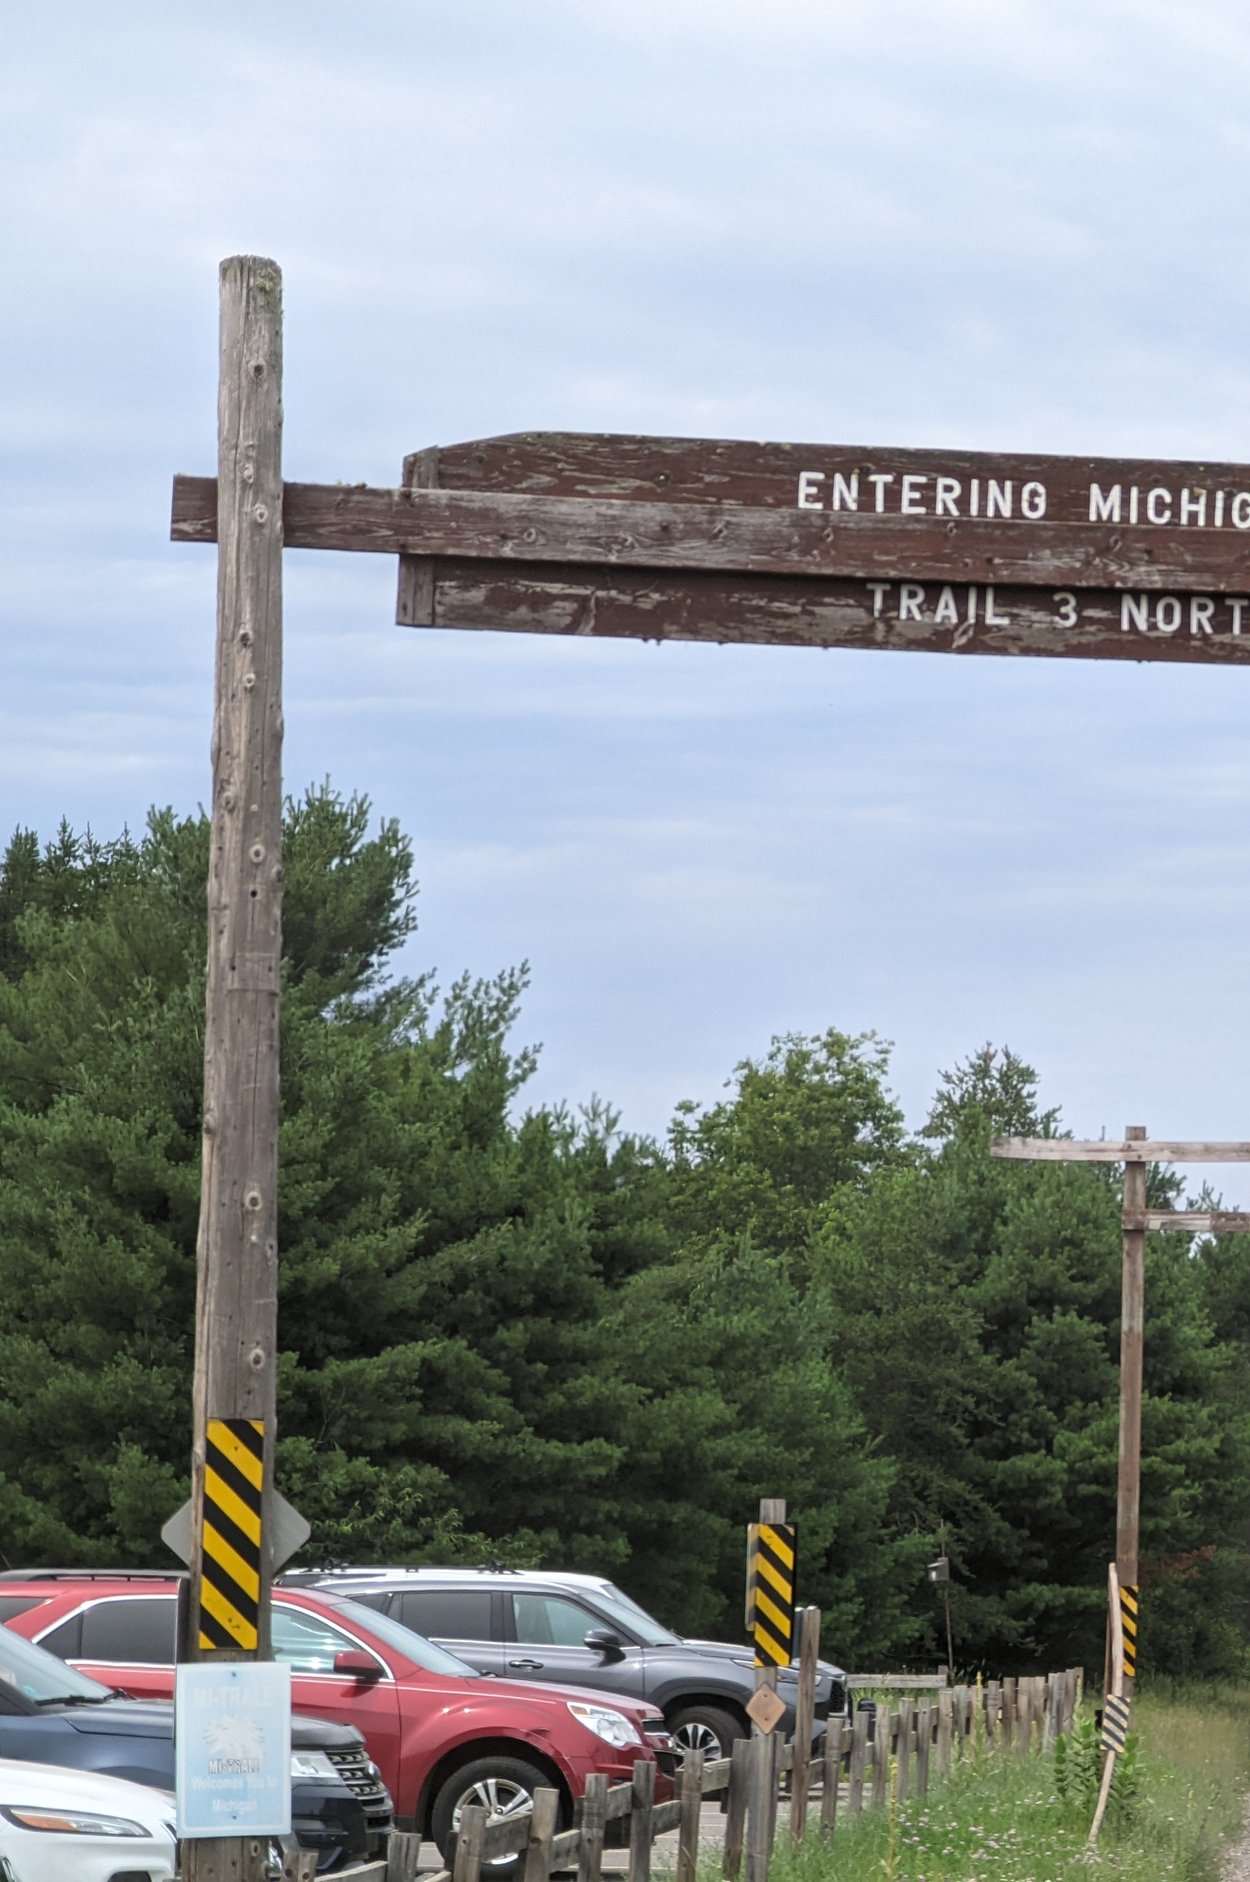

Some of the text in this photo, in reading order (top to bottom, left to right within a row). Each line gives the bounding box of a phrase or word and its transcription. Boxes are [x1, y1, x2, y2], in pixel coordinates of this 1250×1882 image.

[798, 471, 1047, 520] ENTERING
[867, 582, 1010, 627] TRAIL
[1053, 592, 1079, 628] 3
[212, 1799, 258, 1814] Michigan
